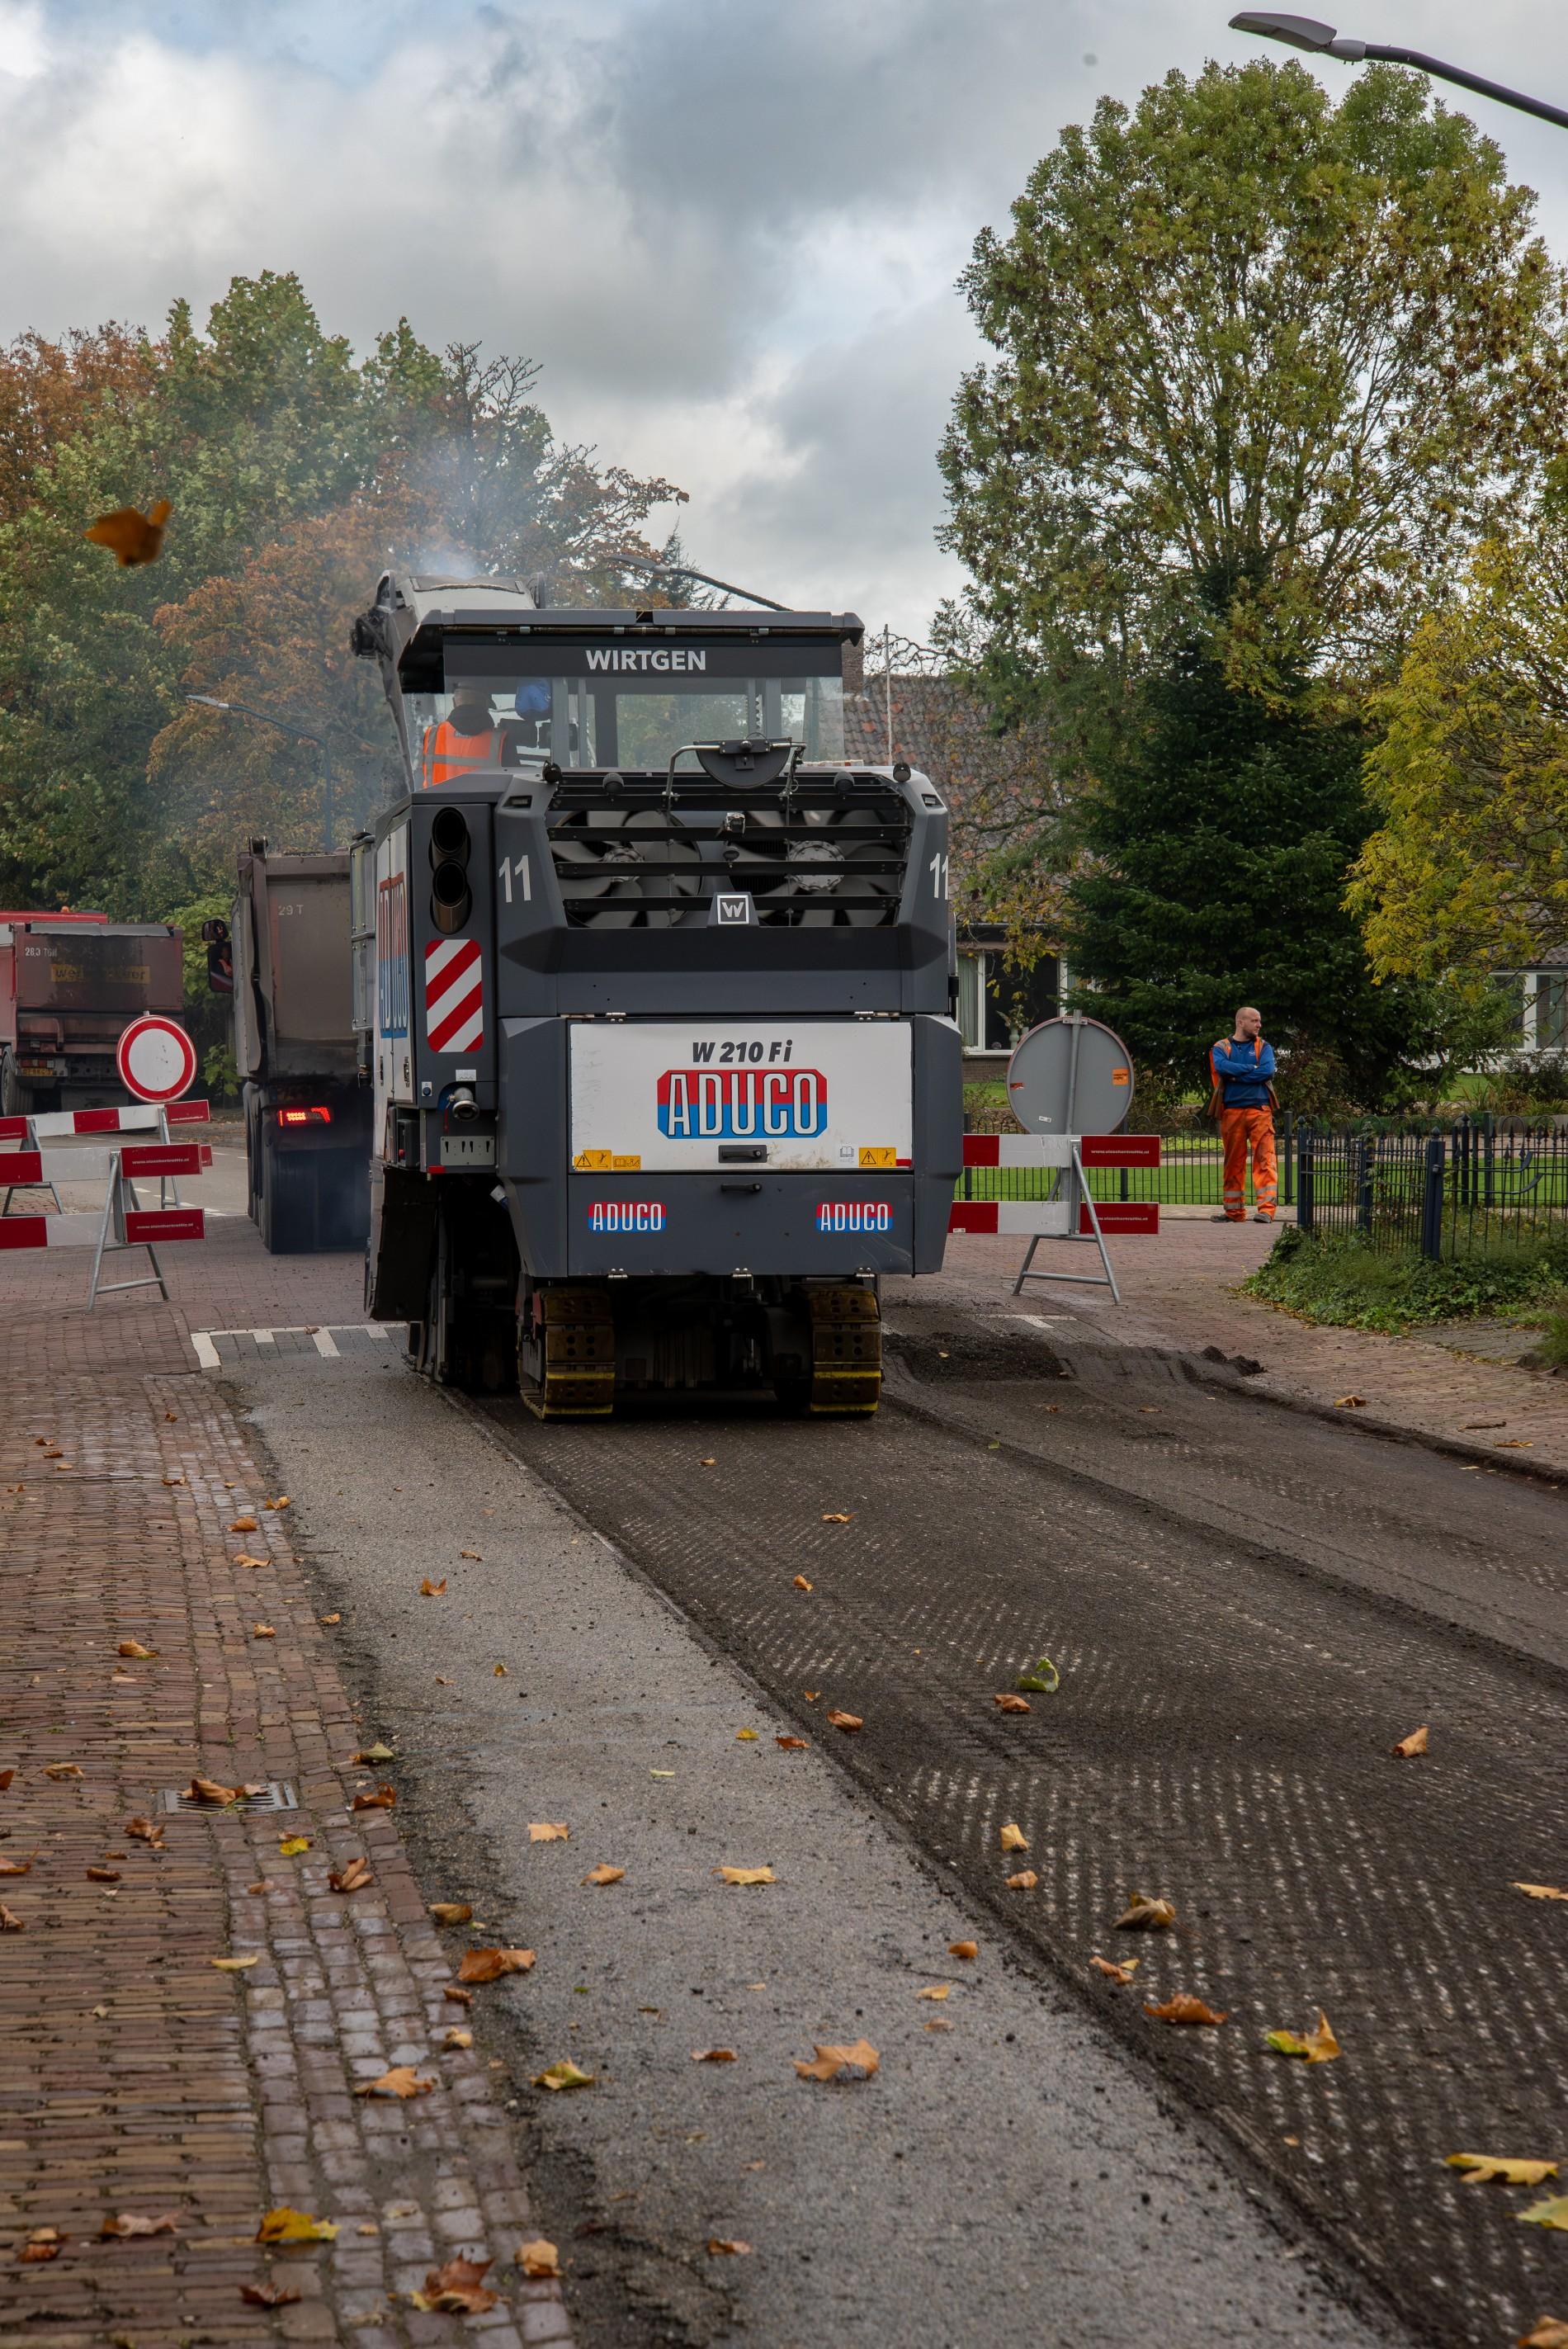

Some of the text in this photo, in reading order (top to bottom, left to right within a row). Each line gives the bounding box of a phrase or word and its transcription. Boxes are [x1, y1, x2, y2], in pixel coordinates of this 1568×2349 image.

[585, 650, 706, 671] WIRTGEN
[498, 854, 531, 903] 11
[929, 853, 949, 900] 11
[277, 903, 305, 916] 29 T
[692, 1039, 793, 1063] W 210 Fi
[667, 1072, 819, 1137] ADUCO
[593, 1203, 662, 1231] ADUCO
[820, 1203, 889, 1231] ADUCO
